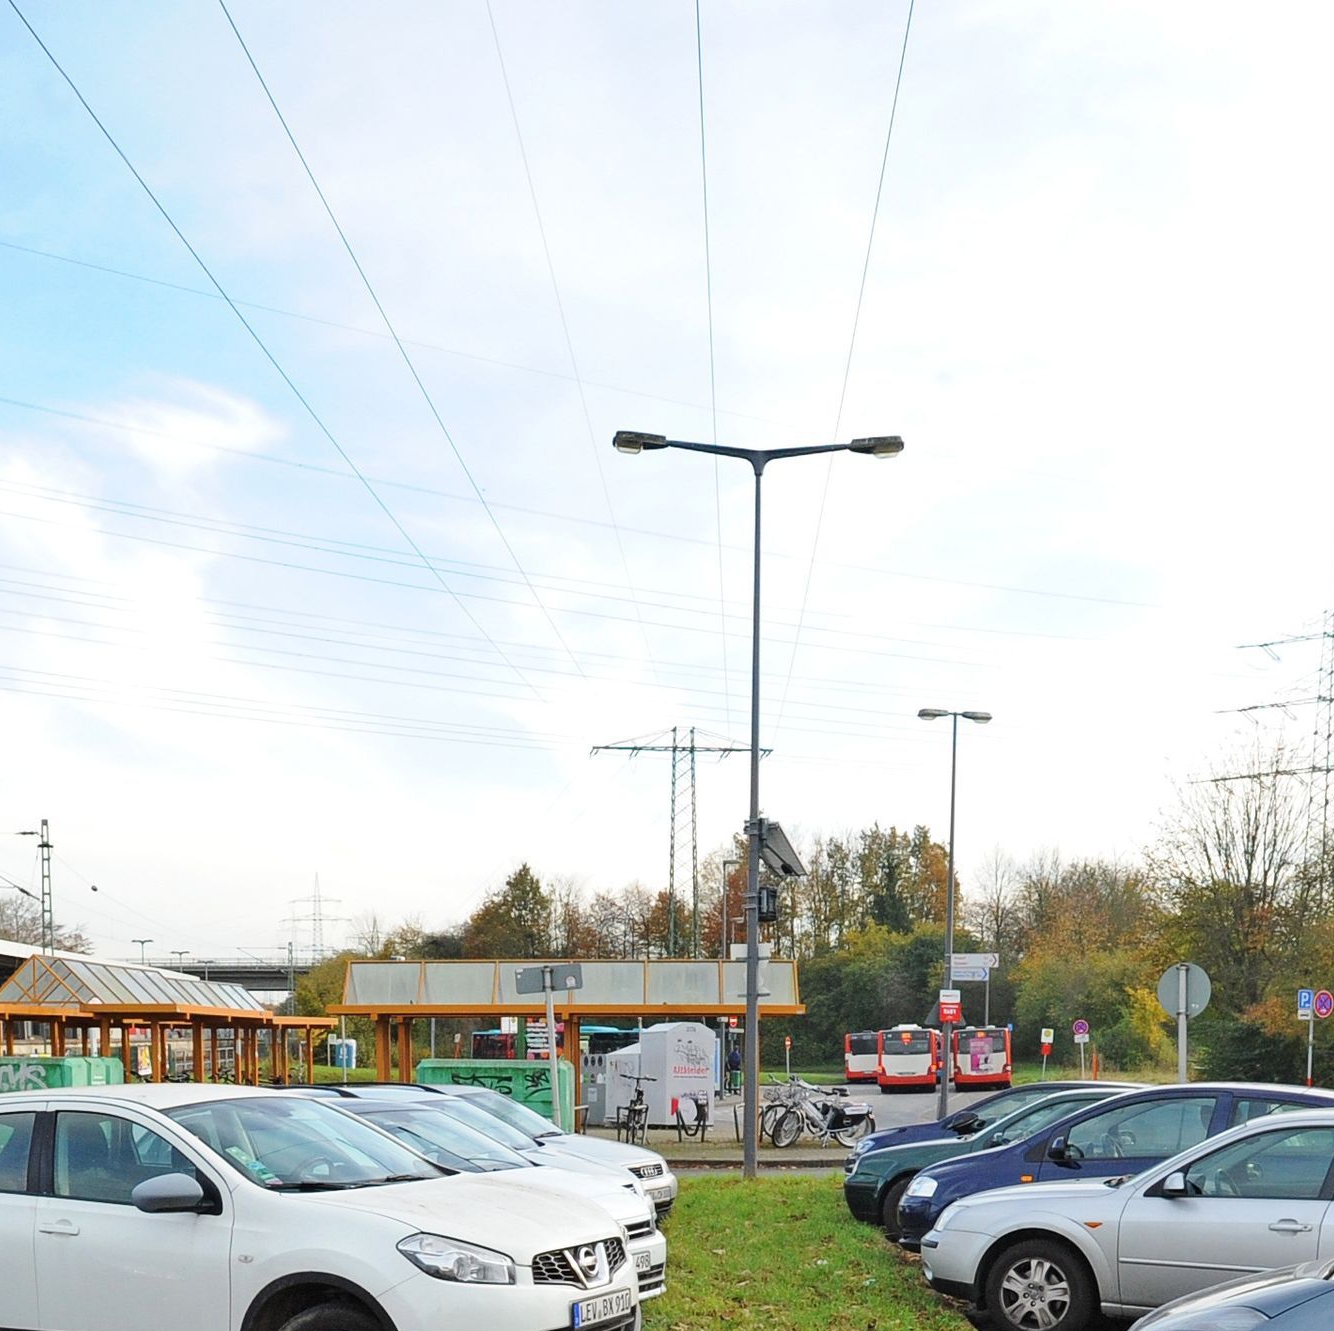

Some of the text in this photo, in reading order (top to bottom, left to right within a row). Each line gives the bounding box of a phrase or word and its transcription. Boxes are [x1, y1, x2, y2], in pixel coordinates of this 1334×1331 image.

[1301, 992, 1309, 1007] P
[580, 1301, 598, 1322] LEV
[603, 1296, 614, 1316] BX
